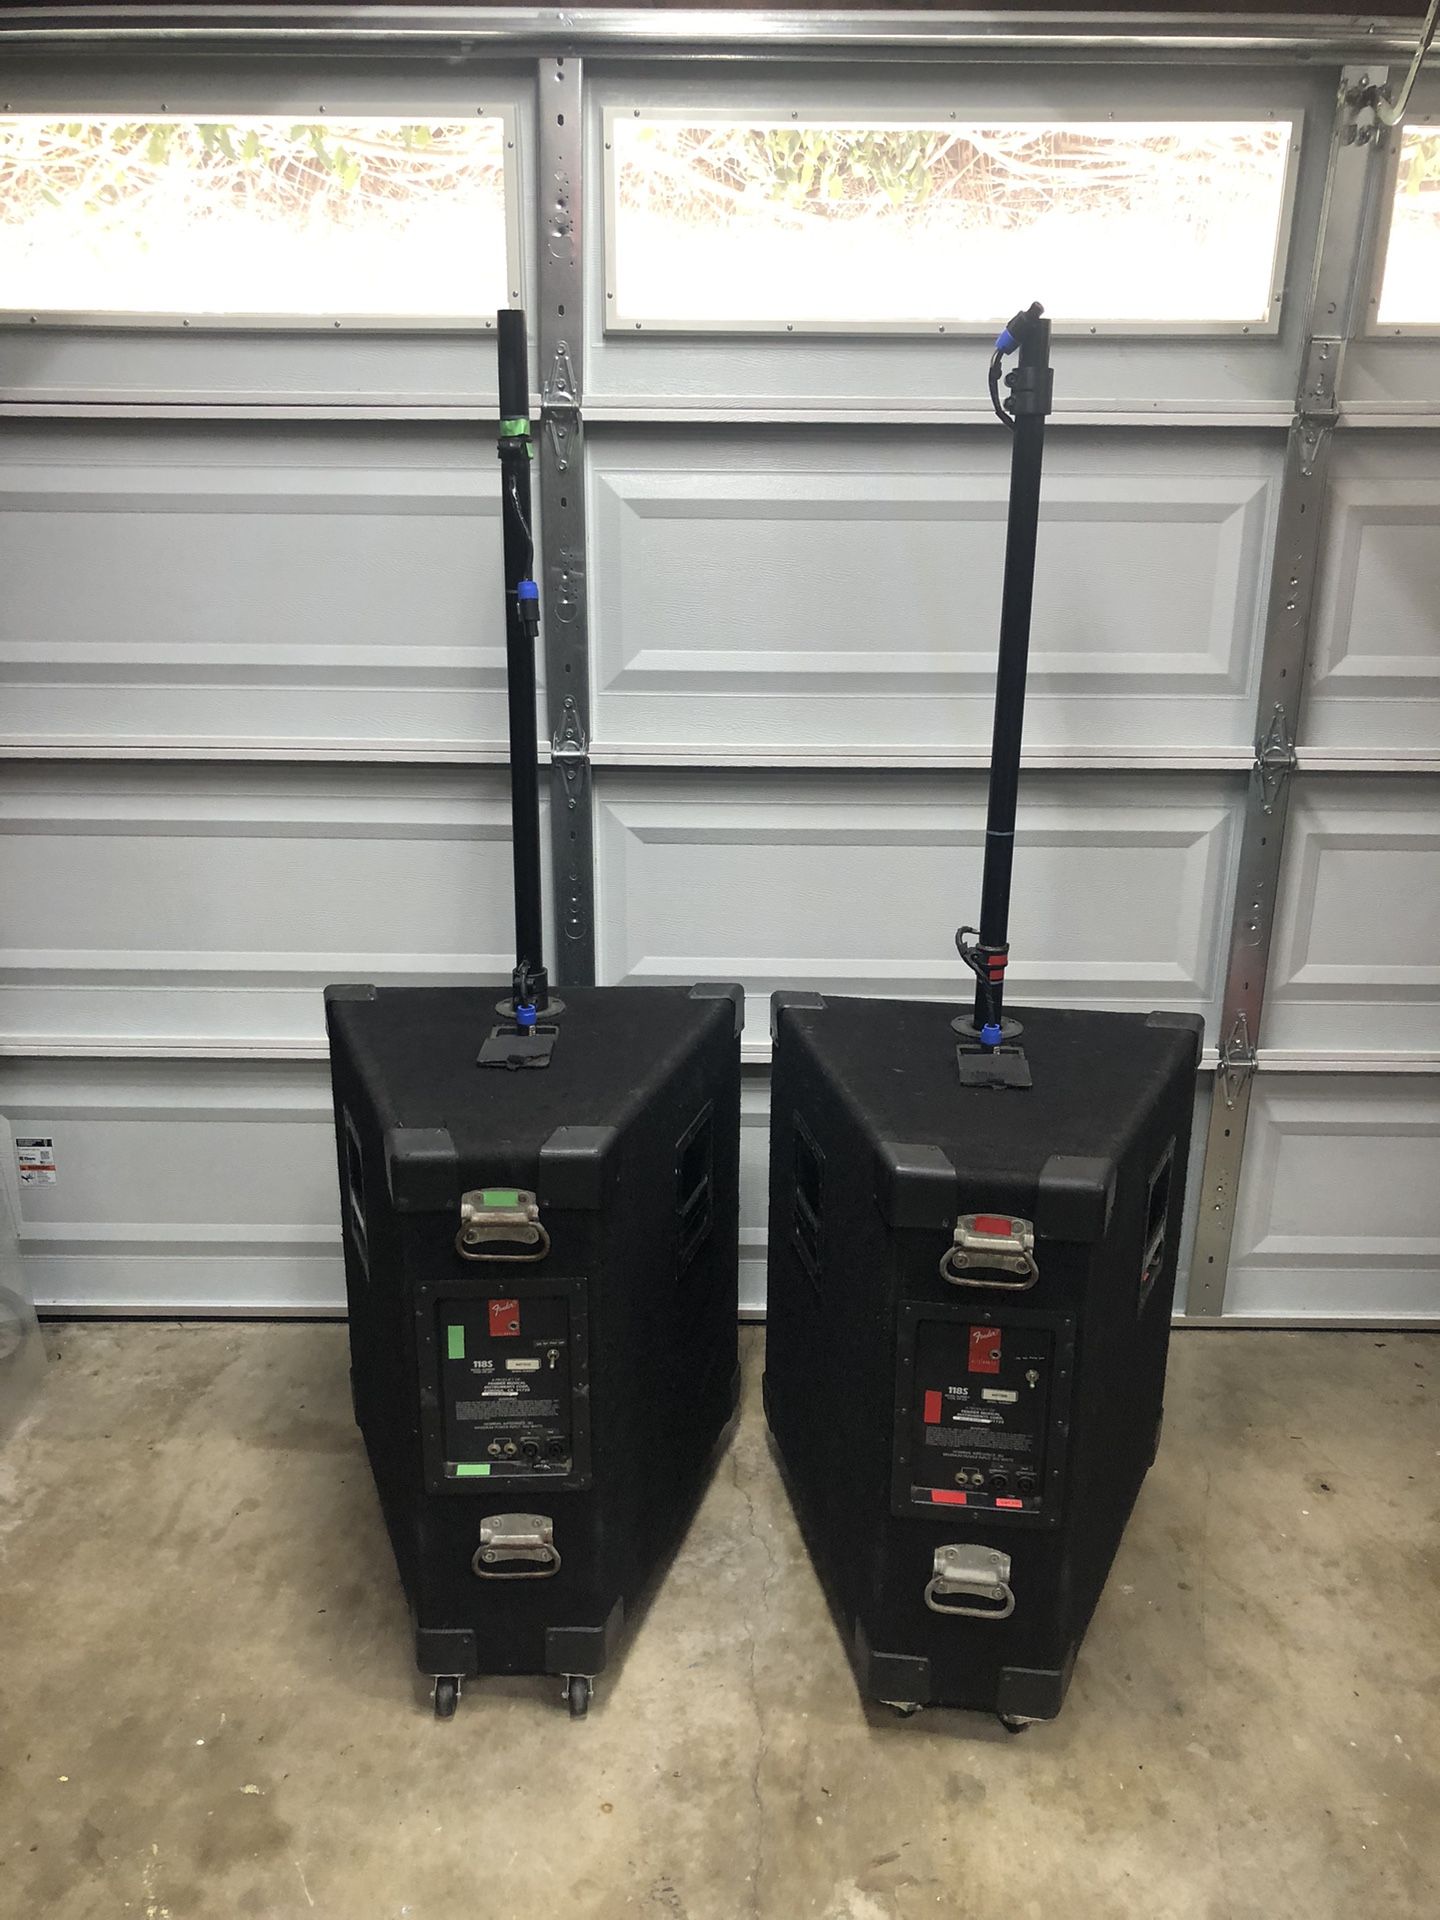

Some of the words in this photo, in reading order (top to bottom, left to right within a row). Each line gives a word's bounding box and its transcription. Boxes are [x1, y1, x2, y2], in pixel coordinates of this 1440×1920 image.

[972, 1329, 997, 1344] Fender
[473, 1360, 493, 1368] 118S
[948, 1386, 969, 1395] 118S
